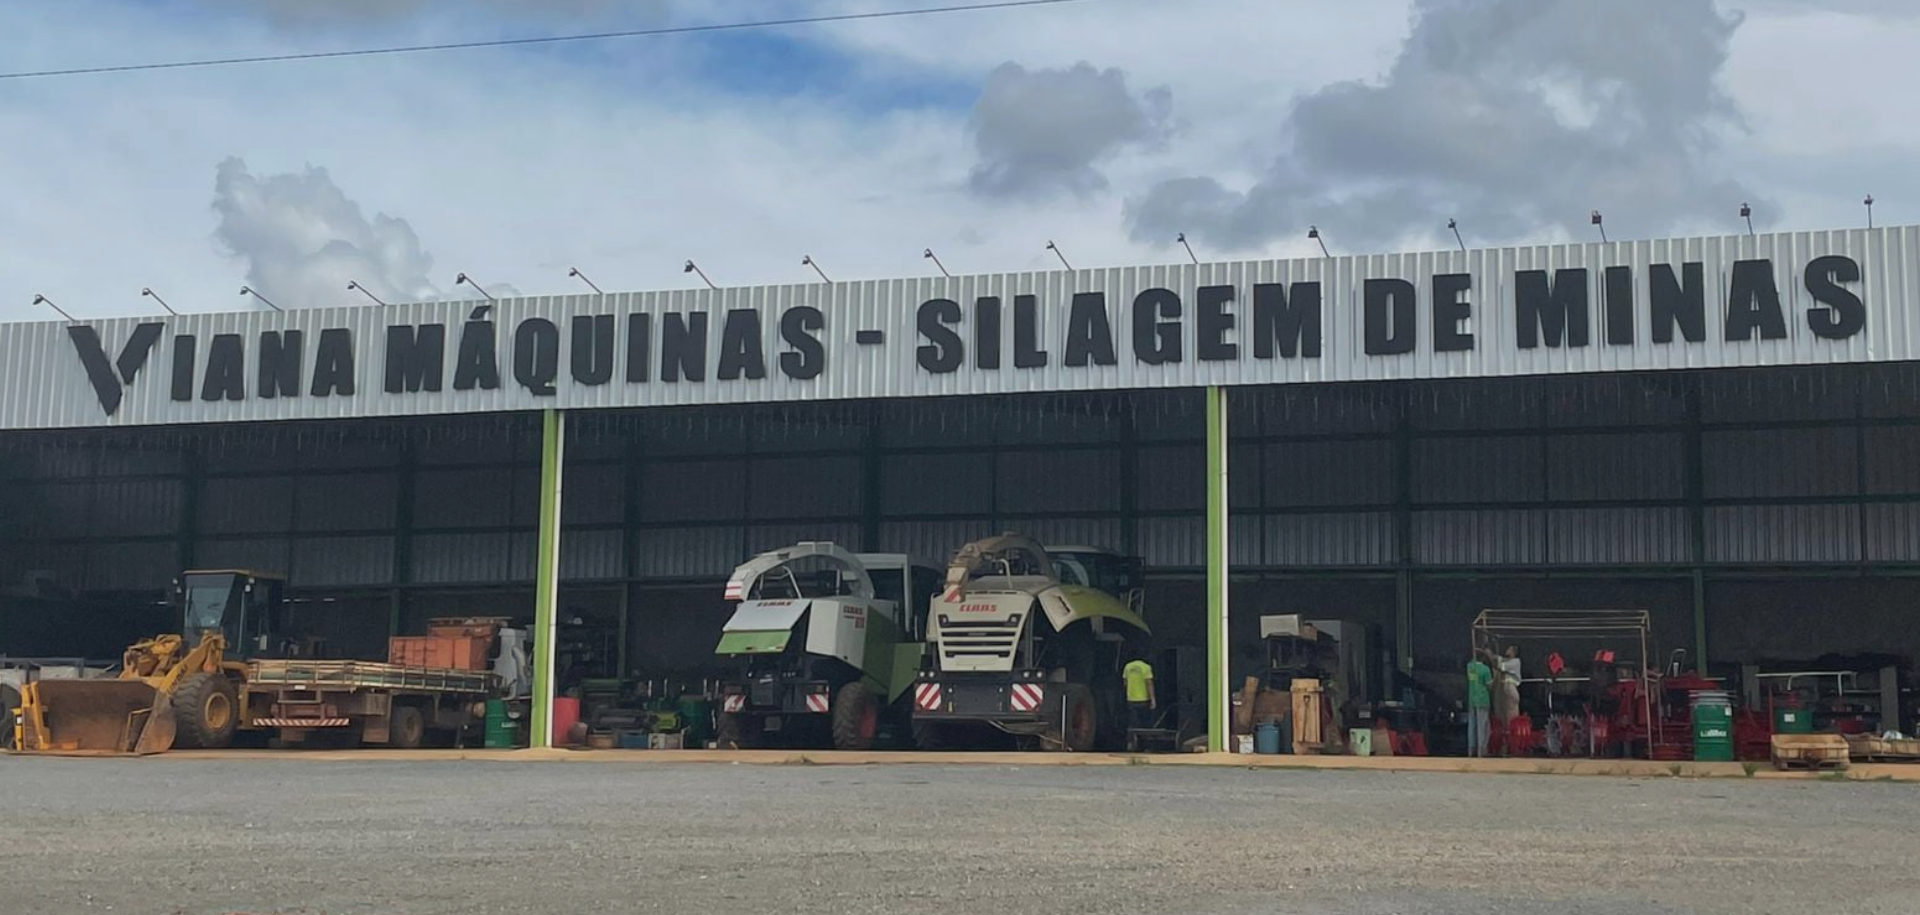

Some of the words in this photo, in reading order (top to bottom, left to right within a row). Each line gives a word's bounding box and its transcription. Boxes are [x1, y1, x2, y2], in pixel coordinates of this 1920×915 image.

[67, 322, 355, 416] VIANA
[384, 305, 825, 397] MÁQUINAS
[856, 330, 885, 345] -
[916, 281, 1322, 375] SILAGEM
[1364, 272, 1475, 358] DE
[1515, 254, 1868, 351] MINAS
